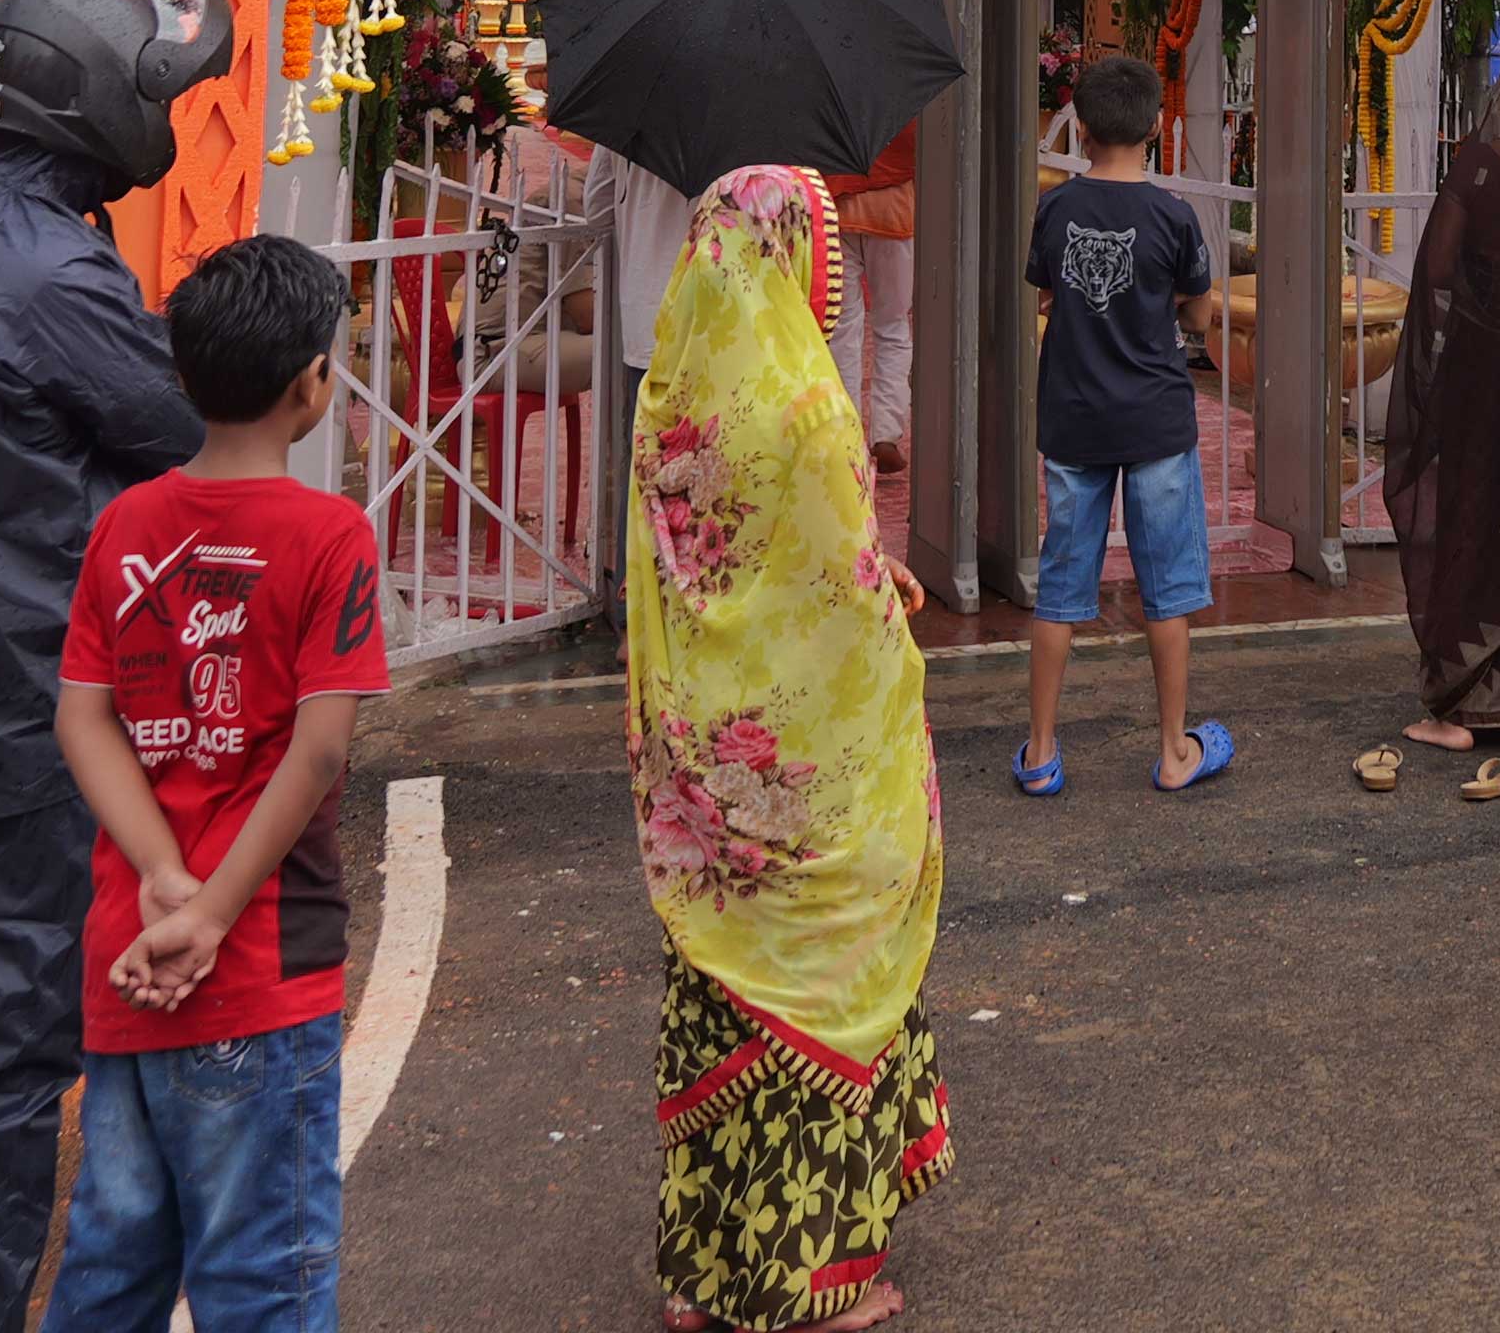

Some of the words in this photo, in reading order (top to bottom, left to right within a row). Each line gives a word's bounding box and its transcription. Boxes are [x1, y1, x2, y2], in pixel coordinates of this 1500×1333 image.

[116, 529, 262, 636] XTREME
[181, 600, 248, 649] Sport
[189, 653, 242, 719] 95
[120, 714, 191, 748] PEED
